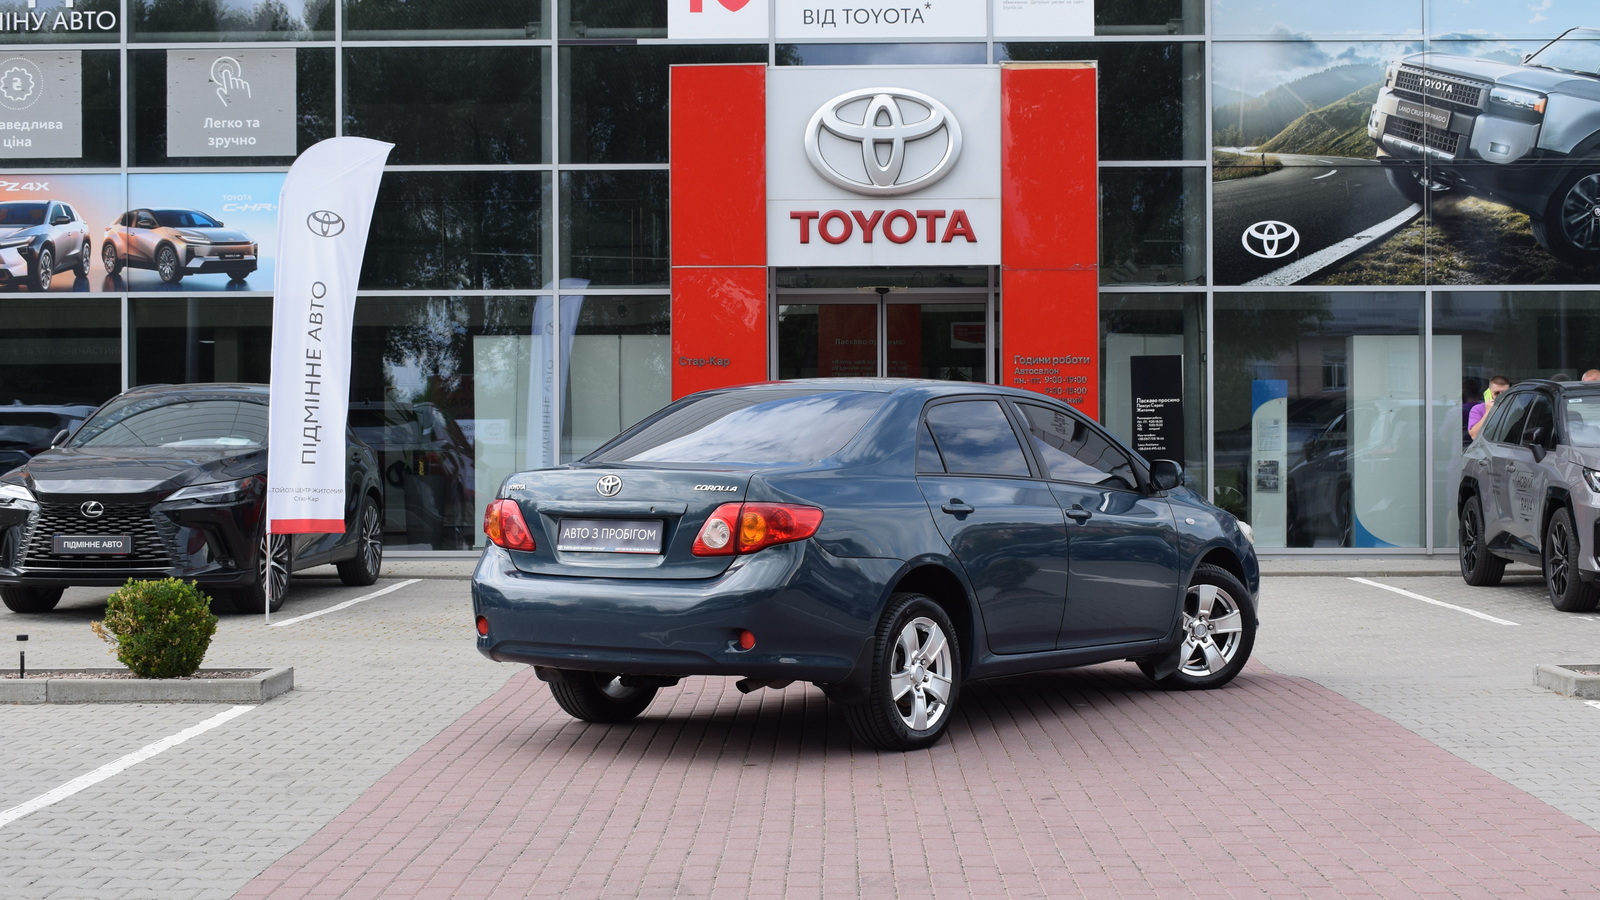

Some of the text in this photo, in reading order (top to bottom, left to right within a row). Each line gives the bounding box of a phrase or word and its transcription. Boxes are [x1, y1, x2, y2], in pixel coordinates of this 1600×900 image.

[52, 10, 116, 30] АВТО
[803, 9, 837, 28] ВІД
[1419, 78, 1453, 93] TOYOTA
[1398, 105, 1411, 114] LAND
[1430, 113, 1447, 123] PRADO
[203, 117, 260, 129] Легко та
[3, 136, 32, 149] ціна
[207, 136, 257, 149] зручно
[789, 208, 978, 245] TOYOTA
[678, 355, 731, 368] Стар-Кар
[1013, 354, 1090, 366] Години роботи
[301, 281, 327, 465] ПІДМІННЕ АВТО
[1013, 367, 1059, 375] Автосалон
[693, 484, 738, 492] COROLLA
[563, 527, 590, 539] АВТО
[601, 528, 657, 541] ПРОБІГОМ
[63, 540, 123, 549] ПІДМІННЕ АВТО
